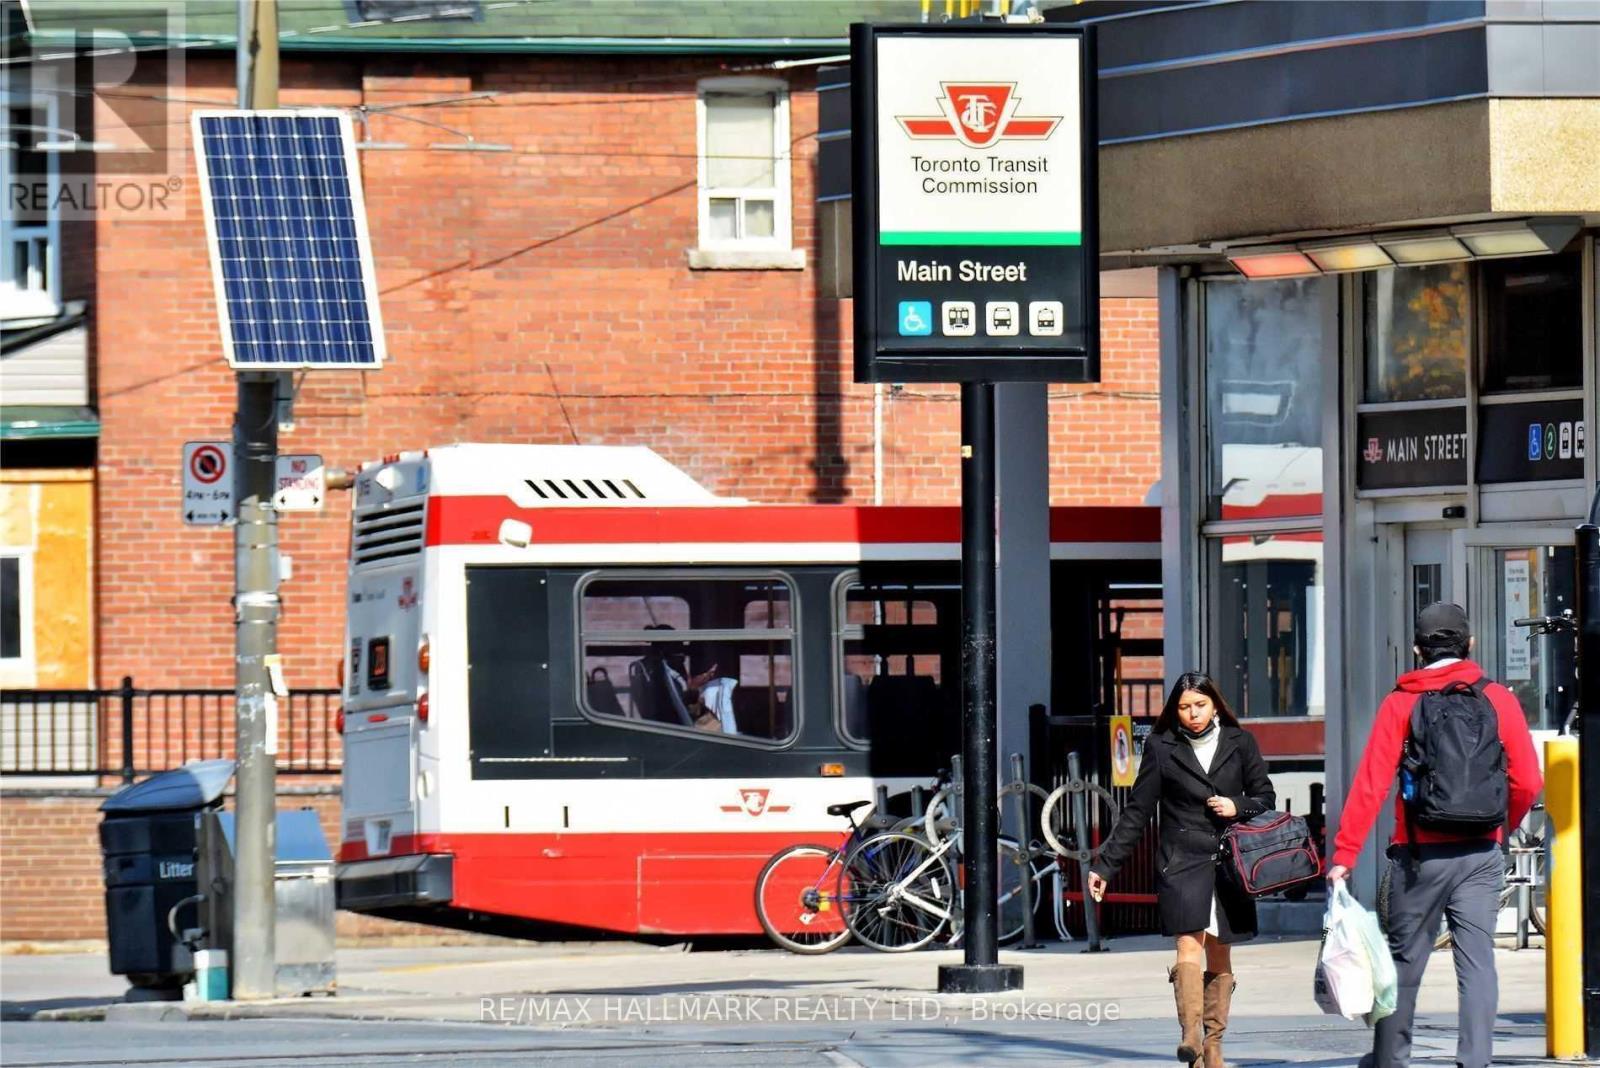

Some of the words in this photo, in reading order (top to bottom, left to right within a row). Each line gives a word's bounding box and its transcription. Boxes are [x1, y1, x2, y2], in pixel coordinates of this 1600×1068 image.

[911, 155, 981, 173] Toronto
[986, 155, 1049, 173] Transit
[921, 177, 1038, 194] Commission
[897, 260, 952, 282] Main
[958, 260, 1027, 282] Street
[1386, 436, 1418, 463] MAIN
[1424, 433, 1467, 461] STREET
[1547, 431, 1554, 452] 2
[159, 861, 195, 879] Litter
